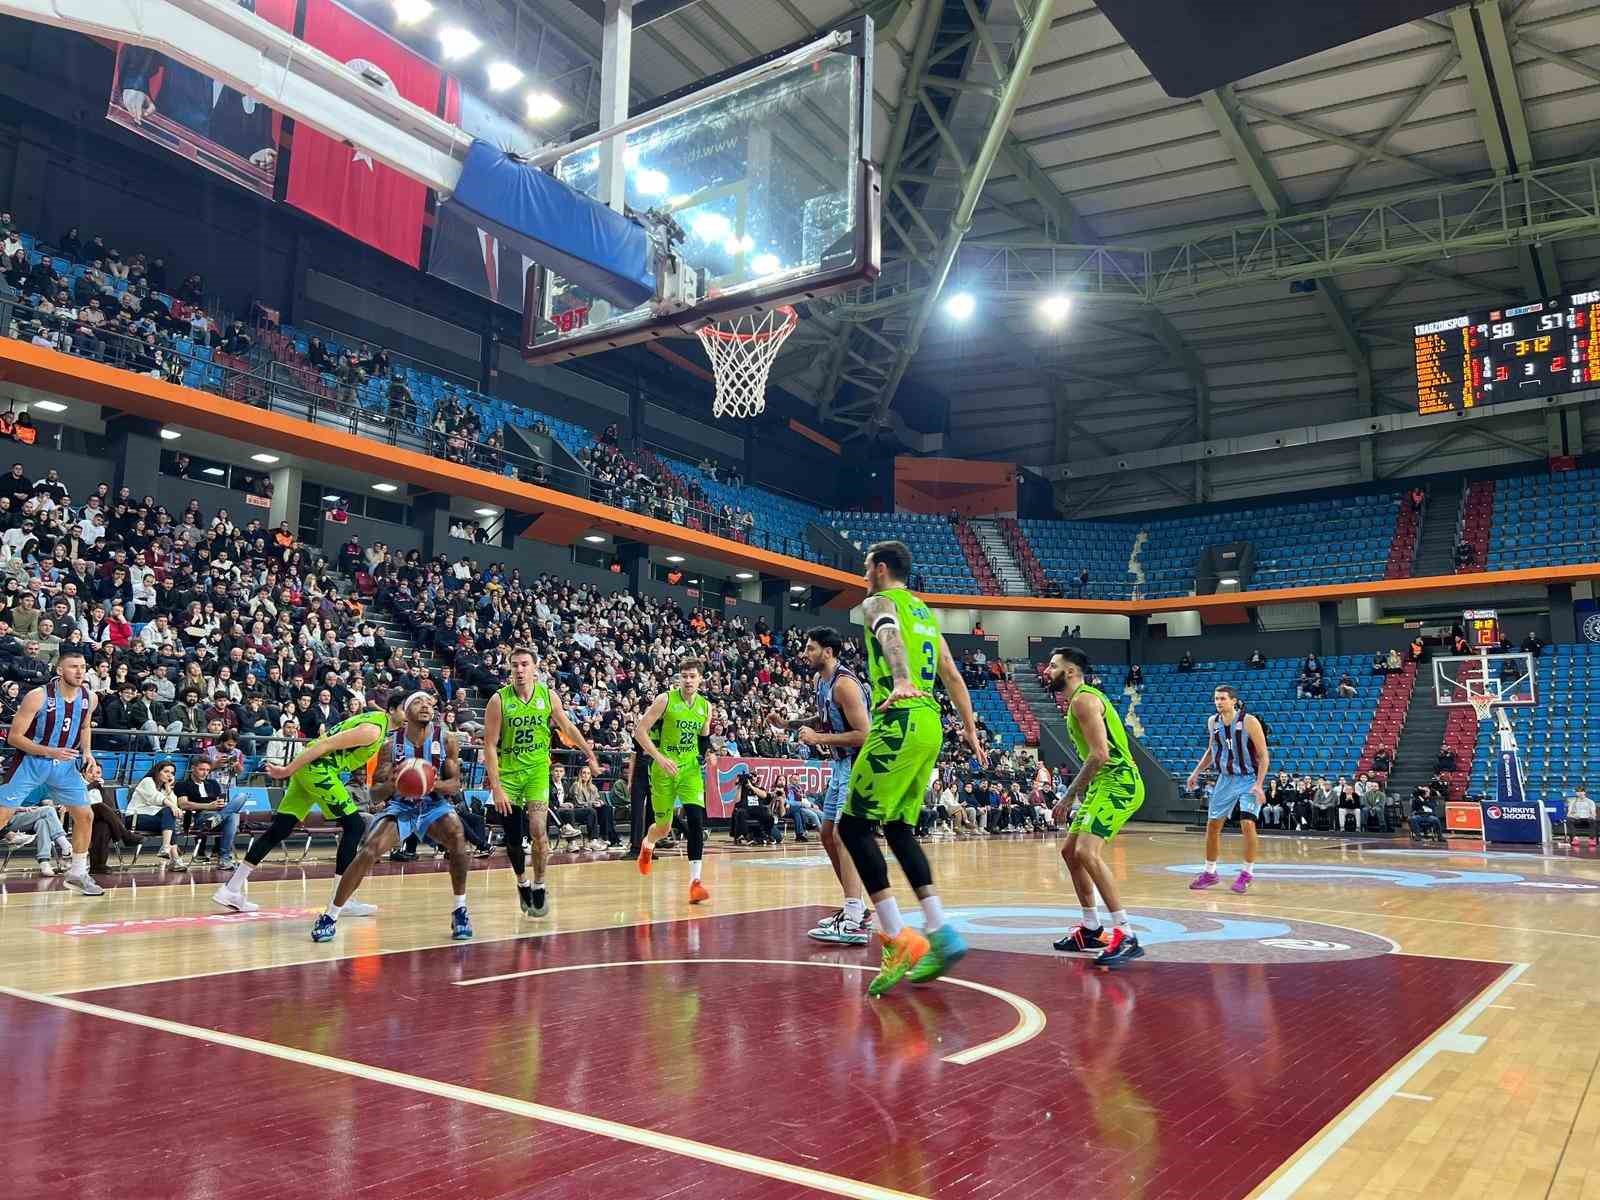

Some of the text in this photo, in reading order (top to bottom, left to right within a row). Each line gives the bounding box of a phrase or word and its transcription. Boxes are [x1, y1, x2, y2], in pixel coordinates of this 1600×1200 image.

[1541, 313, 1563, 331] 57
[1492, 322, 1513, 339] 58
[1524, 363, 1534, 375] 3
[921, 641, 935, 681] 3
[62, 718, 72, 732] 3
[514, 729, 534, 744] 25
